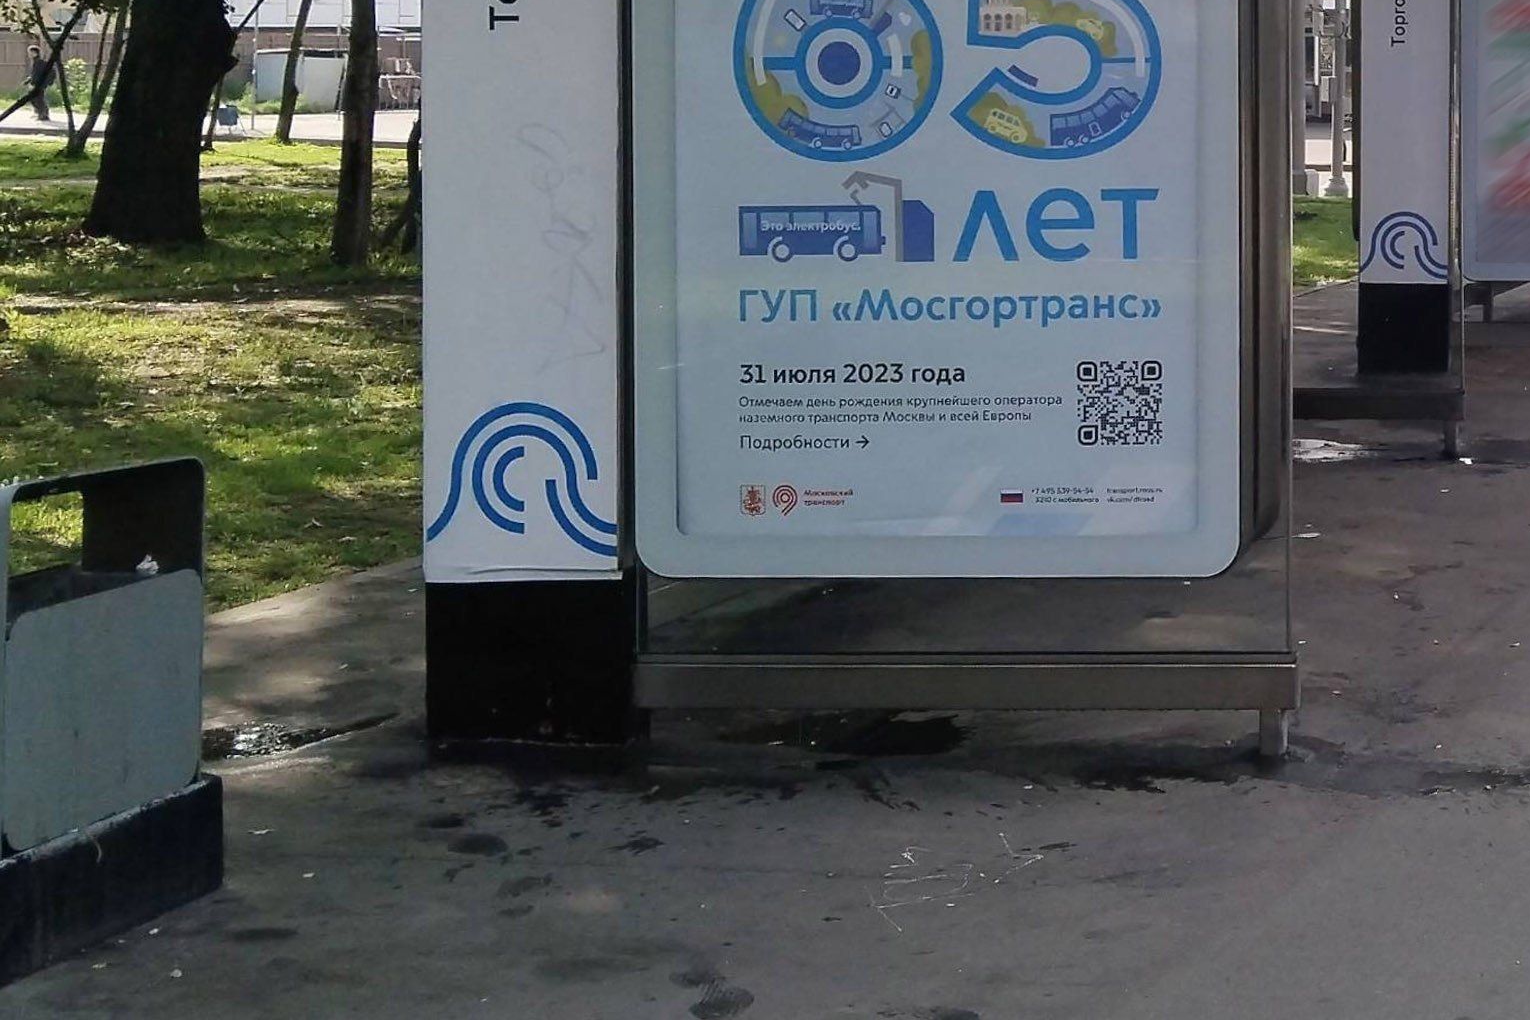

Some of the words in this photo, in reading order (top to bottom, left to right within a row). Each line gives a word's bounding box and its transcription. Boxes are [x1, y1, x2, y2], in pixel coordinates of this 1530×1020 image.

[761, 220, 784, 232] Это
[739, 289, 818, 322] ГУП
[832, 288, 1162, 328] «Мосгортранс»
[739, 364, 767, 384] 31
[773, 368, 836, 383] июля
[842, 363, 904, 384] 2023
[911, 367, 966, 386] года
[739, 396, 804, 407] Отмечаем
[806, 397, 836, 409] день
[839, 396, 903, 409] рождения
[907, 395, 992, 409] крупнейшего
[994, 395, 1063, 407] оператора
[739, 412, 806, 423] наземного
[808, 412, 880, 425] транспорта
[882, 411, 936, 422] Москвы
[938, 412, 947, 421] и
[950, 410, 979, 421] всей
[982, 410, 1032, 423] Европы
[739, 434, 850, 452] Подробности
